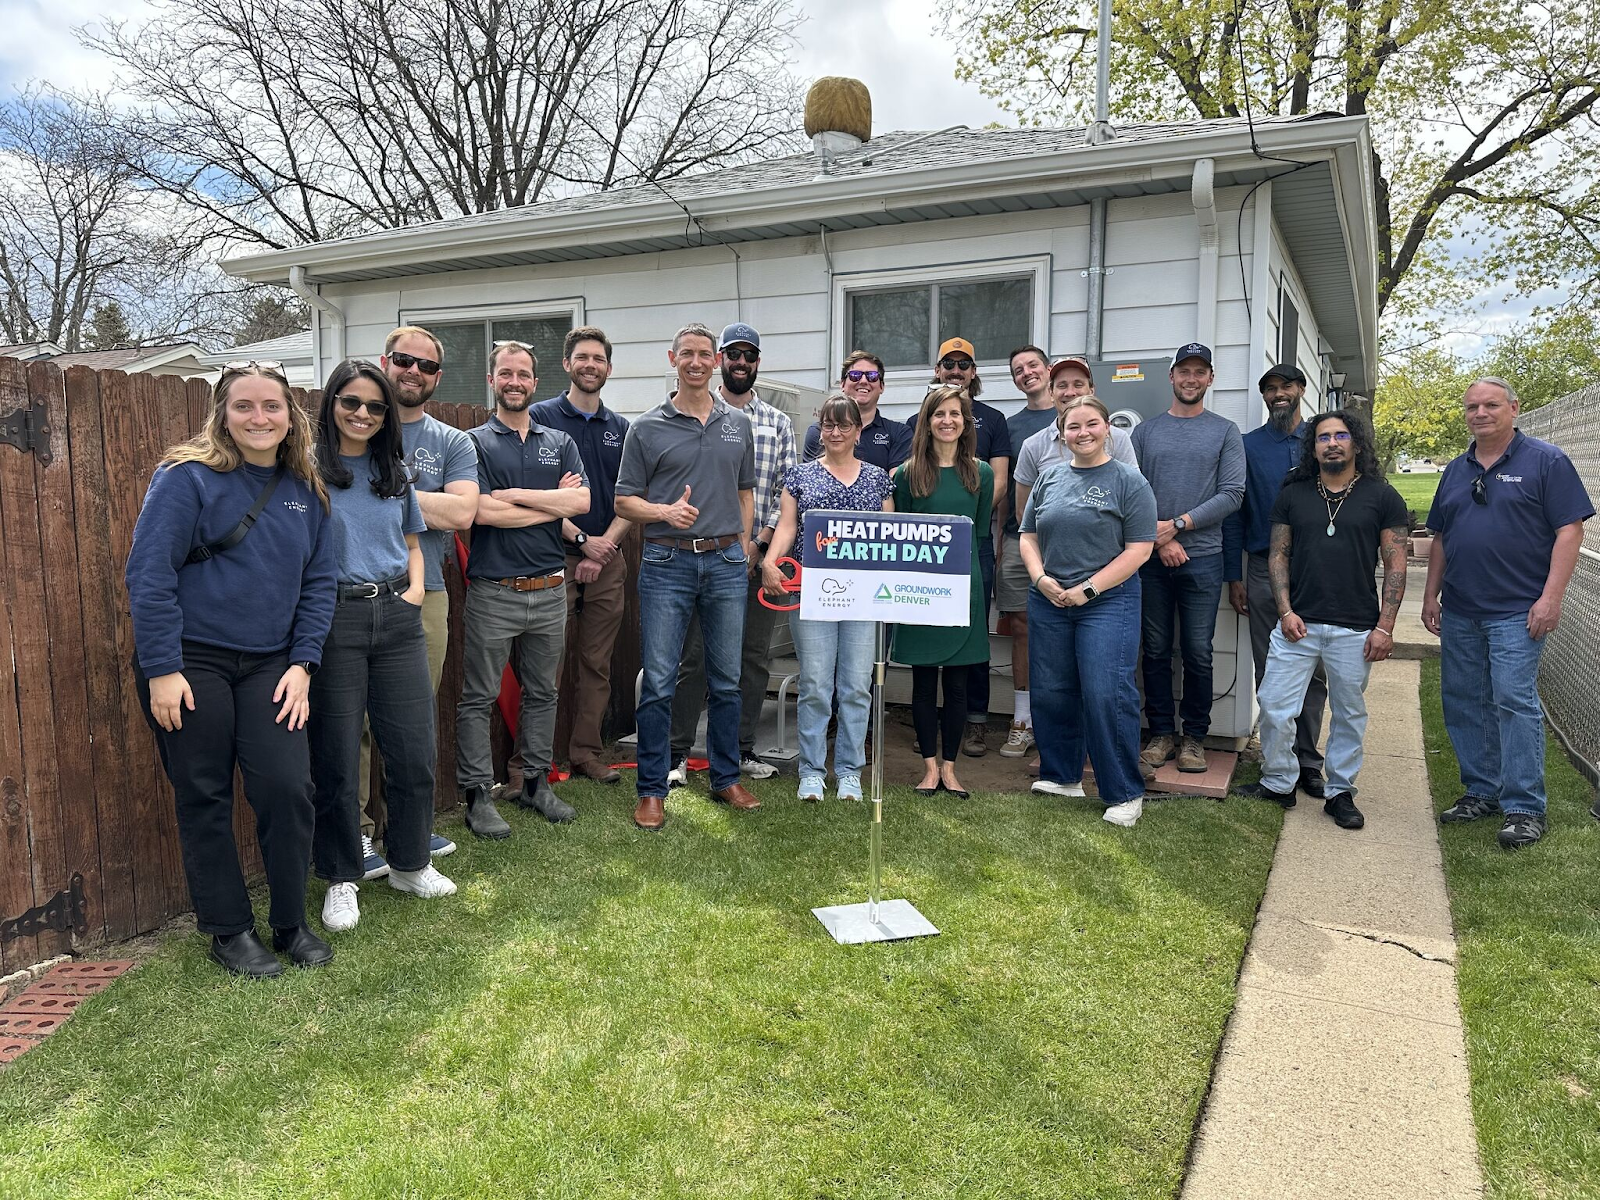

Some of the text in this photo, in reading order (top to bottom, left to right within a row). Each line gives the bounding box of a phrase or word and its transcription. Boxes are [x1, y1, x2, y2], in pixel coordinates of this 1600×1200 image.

[816, 531, 839, 552] for
[827, 519, 952, 543] HEAT PUMPS
[826, 541, 949, 564] EARTH DAY
[894, 584, 952, 596] GROUNDWORK
[894, 595, 930, 605] DENVER
